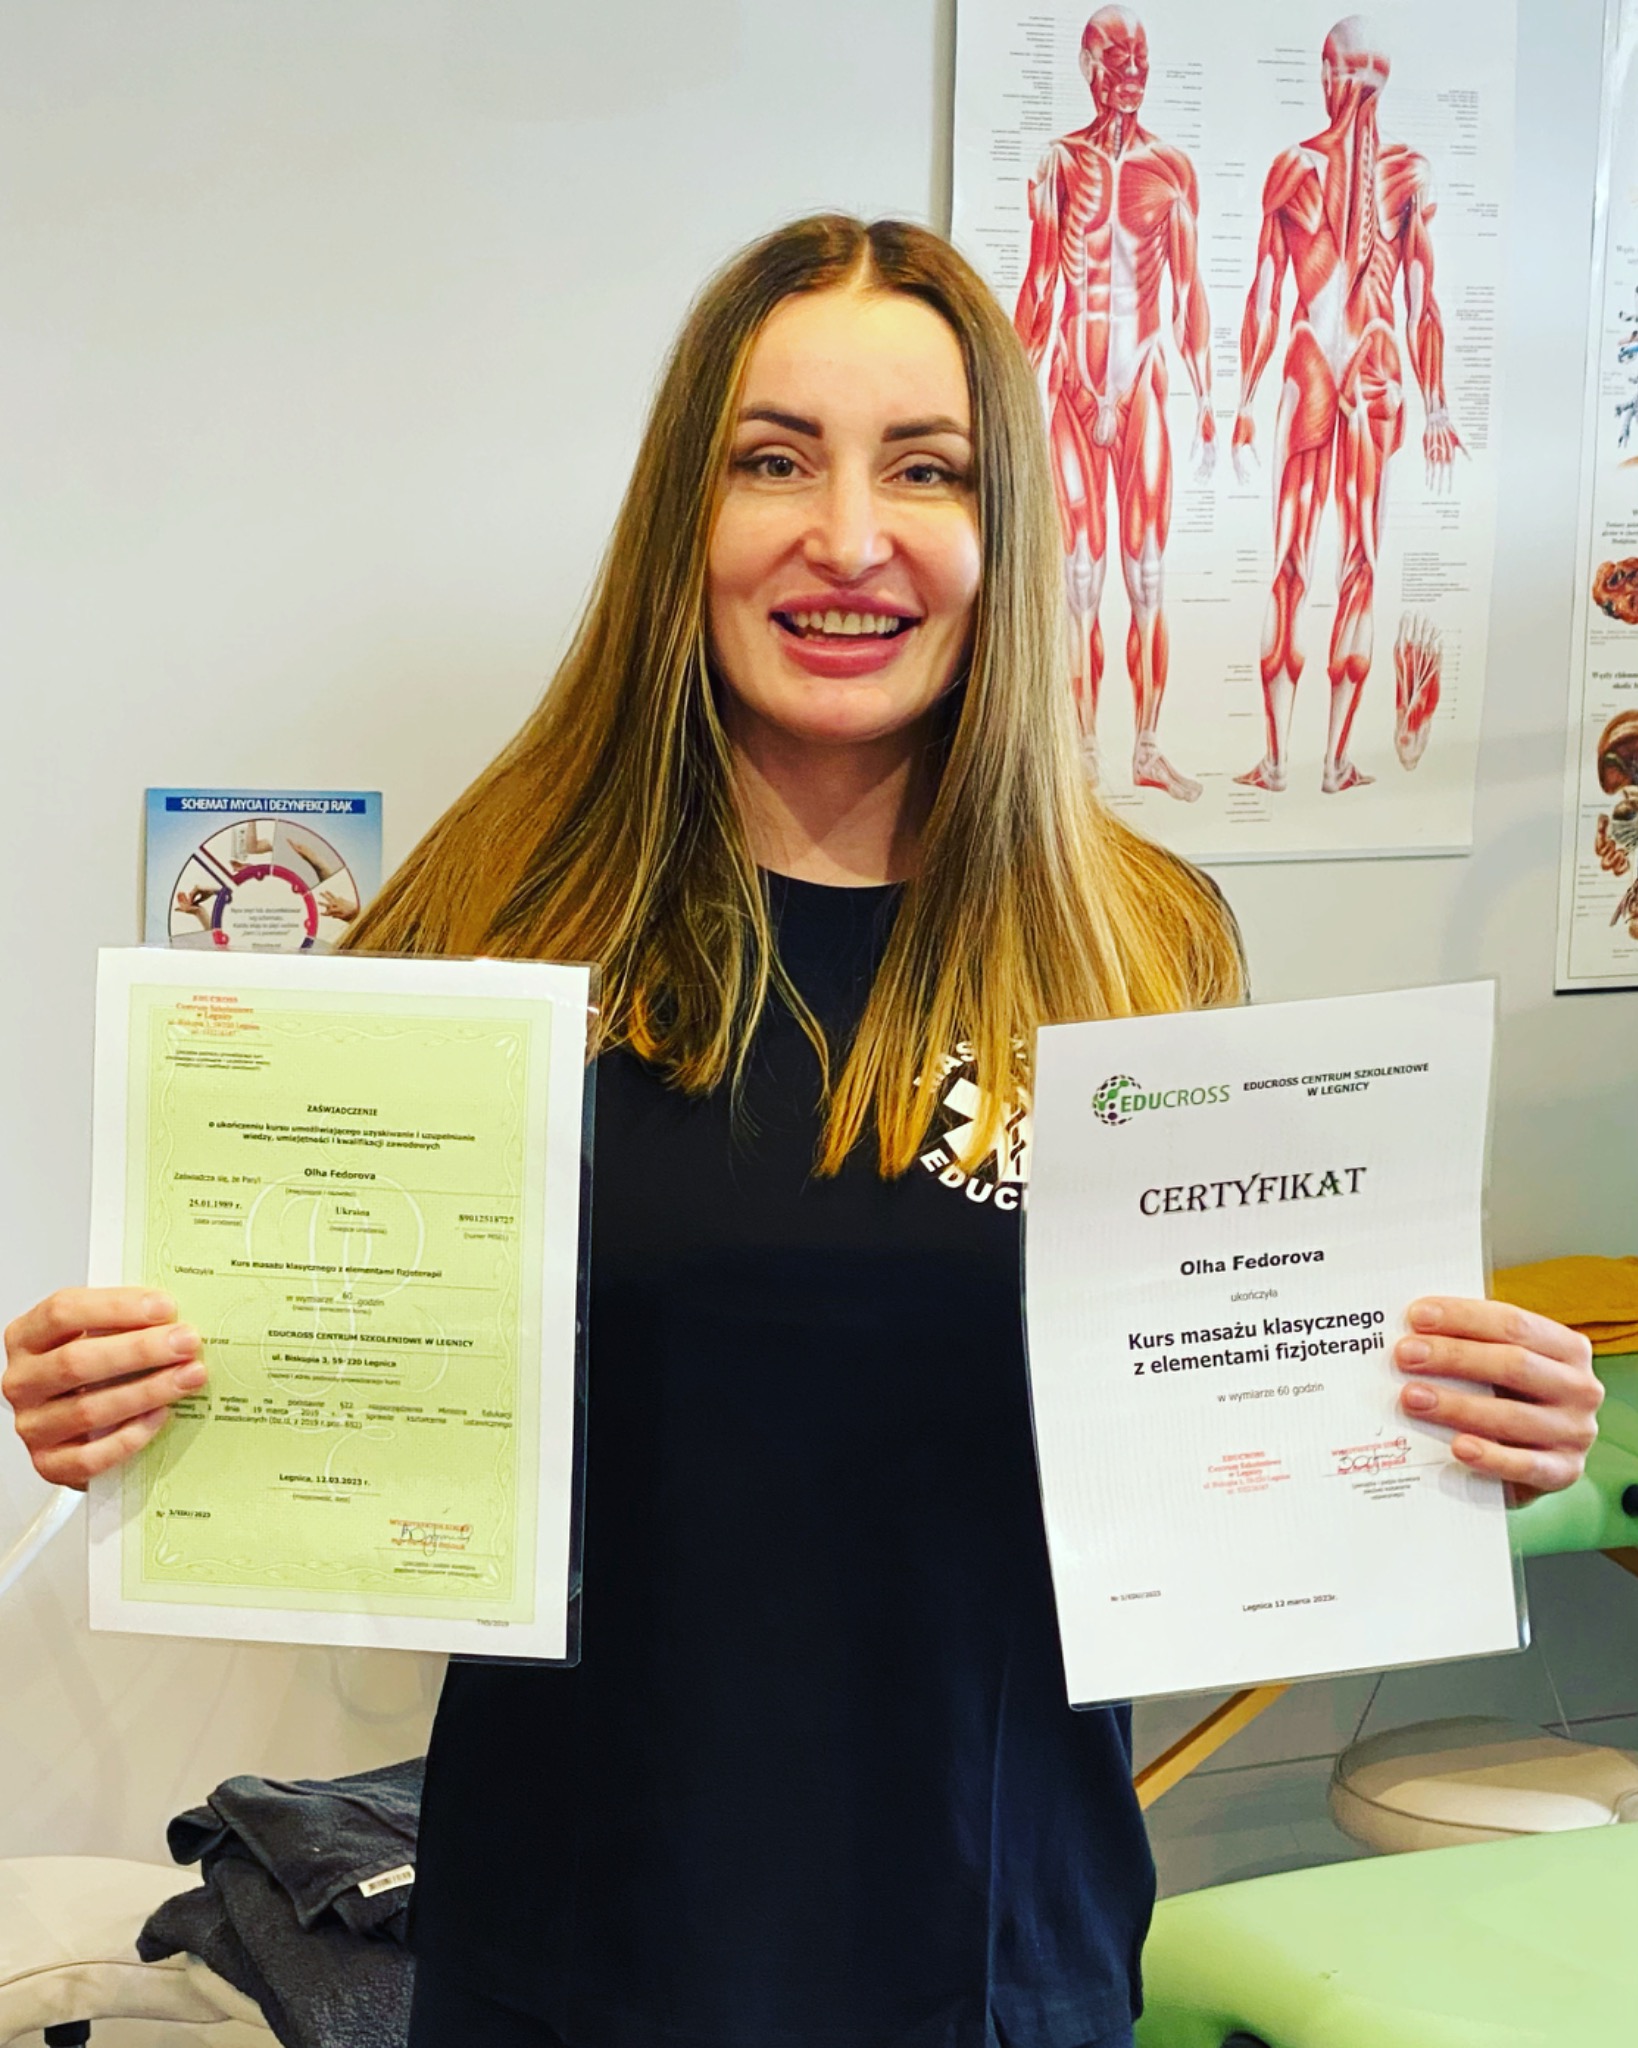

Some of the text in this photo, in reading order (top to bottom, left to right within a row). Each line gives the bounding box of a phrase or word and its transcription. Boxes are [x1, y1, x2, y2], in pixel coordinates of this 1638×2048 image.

[181, 798, 229, 810] SCHEMAT
[230, 799, 263, 811] MYCIA
[269, 800, 330, 814] DEZYNFEKCJI
[1243, 1063, 1430, 1091] EDUCROSS CENTRUM SZKOLENIOWE
[1307, 1081, 1370, 1097] W LEGNICY
[1121, 1084, 1231, 1113] EDUCROSS
[307, 1104, 378, 1116] ZAŚWIADCZENIE
[266, 1122, 290, 1131] kursu
[304, 1168, 376, 1180] Olha Fedorova
[1139, 1166, 1368, 1217] CERTYFIKAT
[189, 1198, 234, 1209] 25.01.1989
[336, 1206, 370, 1217] Ukraina
[231, 1259, 251, 1268] Kurs
[286, 1262, 336, 1273] klasycznego
[345, 1266, 395, 1275] elementami
[1180, 1250, 1325, 1276] Olha Fedorova
[1230, 1286, 1279, 1303] ukończyła
[1128, 1310, 1385, 1350] Kurs masażu klasycznego
[268, 1329, 474, 1348] EDUCROSS CENTRUM SZKOLENIOWE W LEGNICY
[284, 1354, 320, 1364] Biskupia
[364, 1358, 397, 1368] Legnica
[1134, 1332, 1385, 1376] z elementami fizjoterapii
[1217, 1381, 1325, 1404] w wymiarze 60 godzin
[279, 1473, 314, 1484] Legnica,
[315, 1474, 363, 1486] 12.03.2023
[1242, 1602, 1273, 1612] Legnica
[1275, 1599, 1285, 1608] 12
[1286, 1597, 1311, 1606] marca
